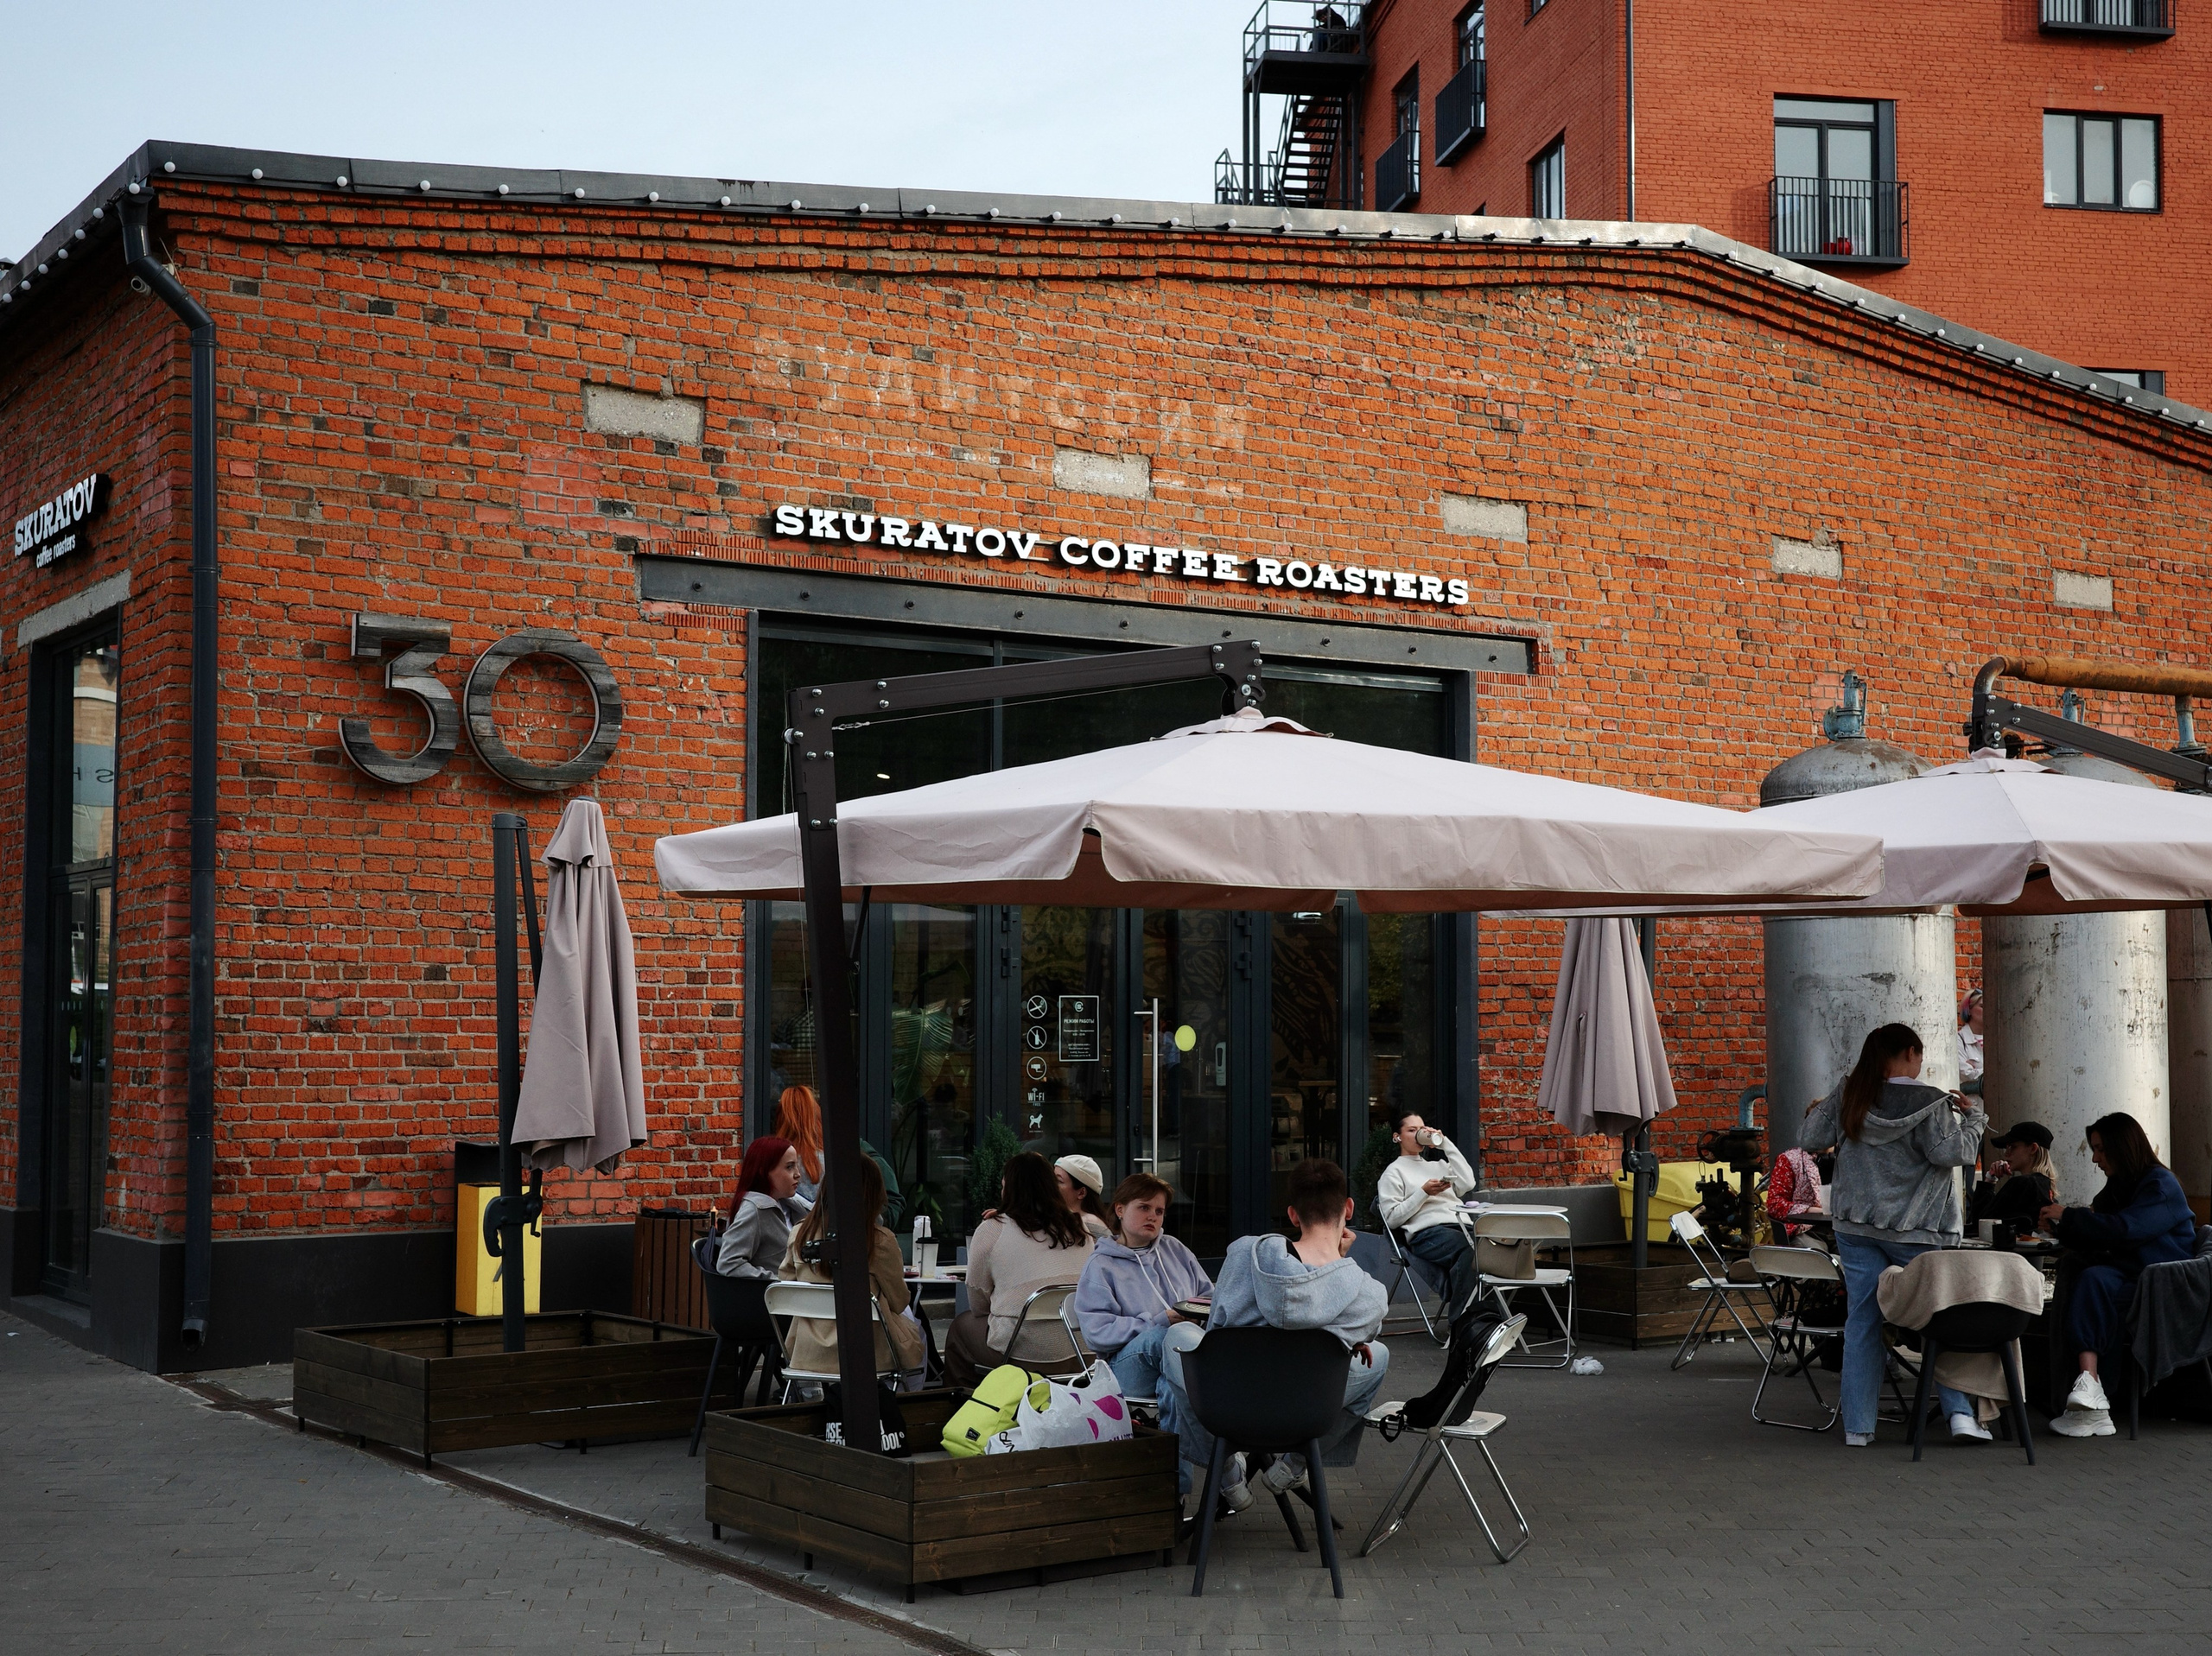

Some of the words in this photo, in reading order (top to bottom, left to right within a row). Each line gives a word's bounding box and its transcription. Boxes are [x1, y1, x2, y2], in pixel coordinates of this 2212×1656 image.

[15, 473, 97, 556] SKURATOV
[775, 504, 1040, 559] SKURATOV
[1059, 536, 1238, 581] COFFEE
[1256, 557, 1470, 605] ROASTERS
[339, 612, 623, 792] 30
